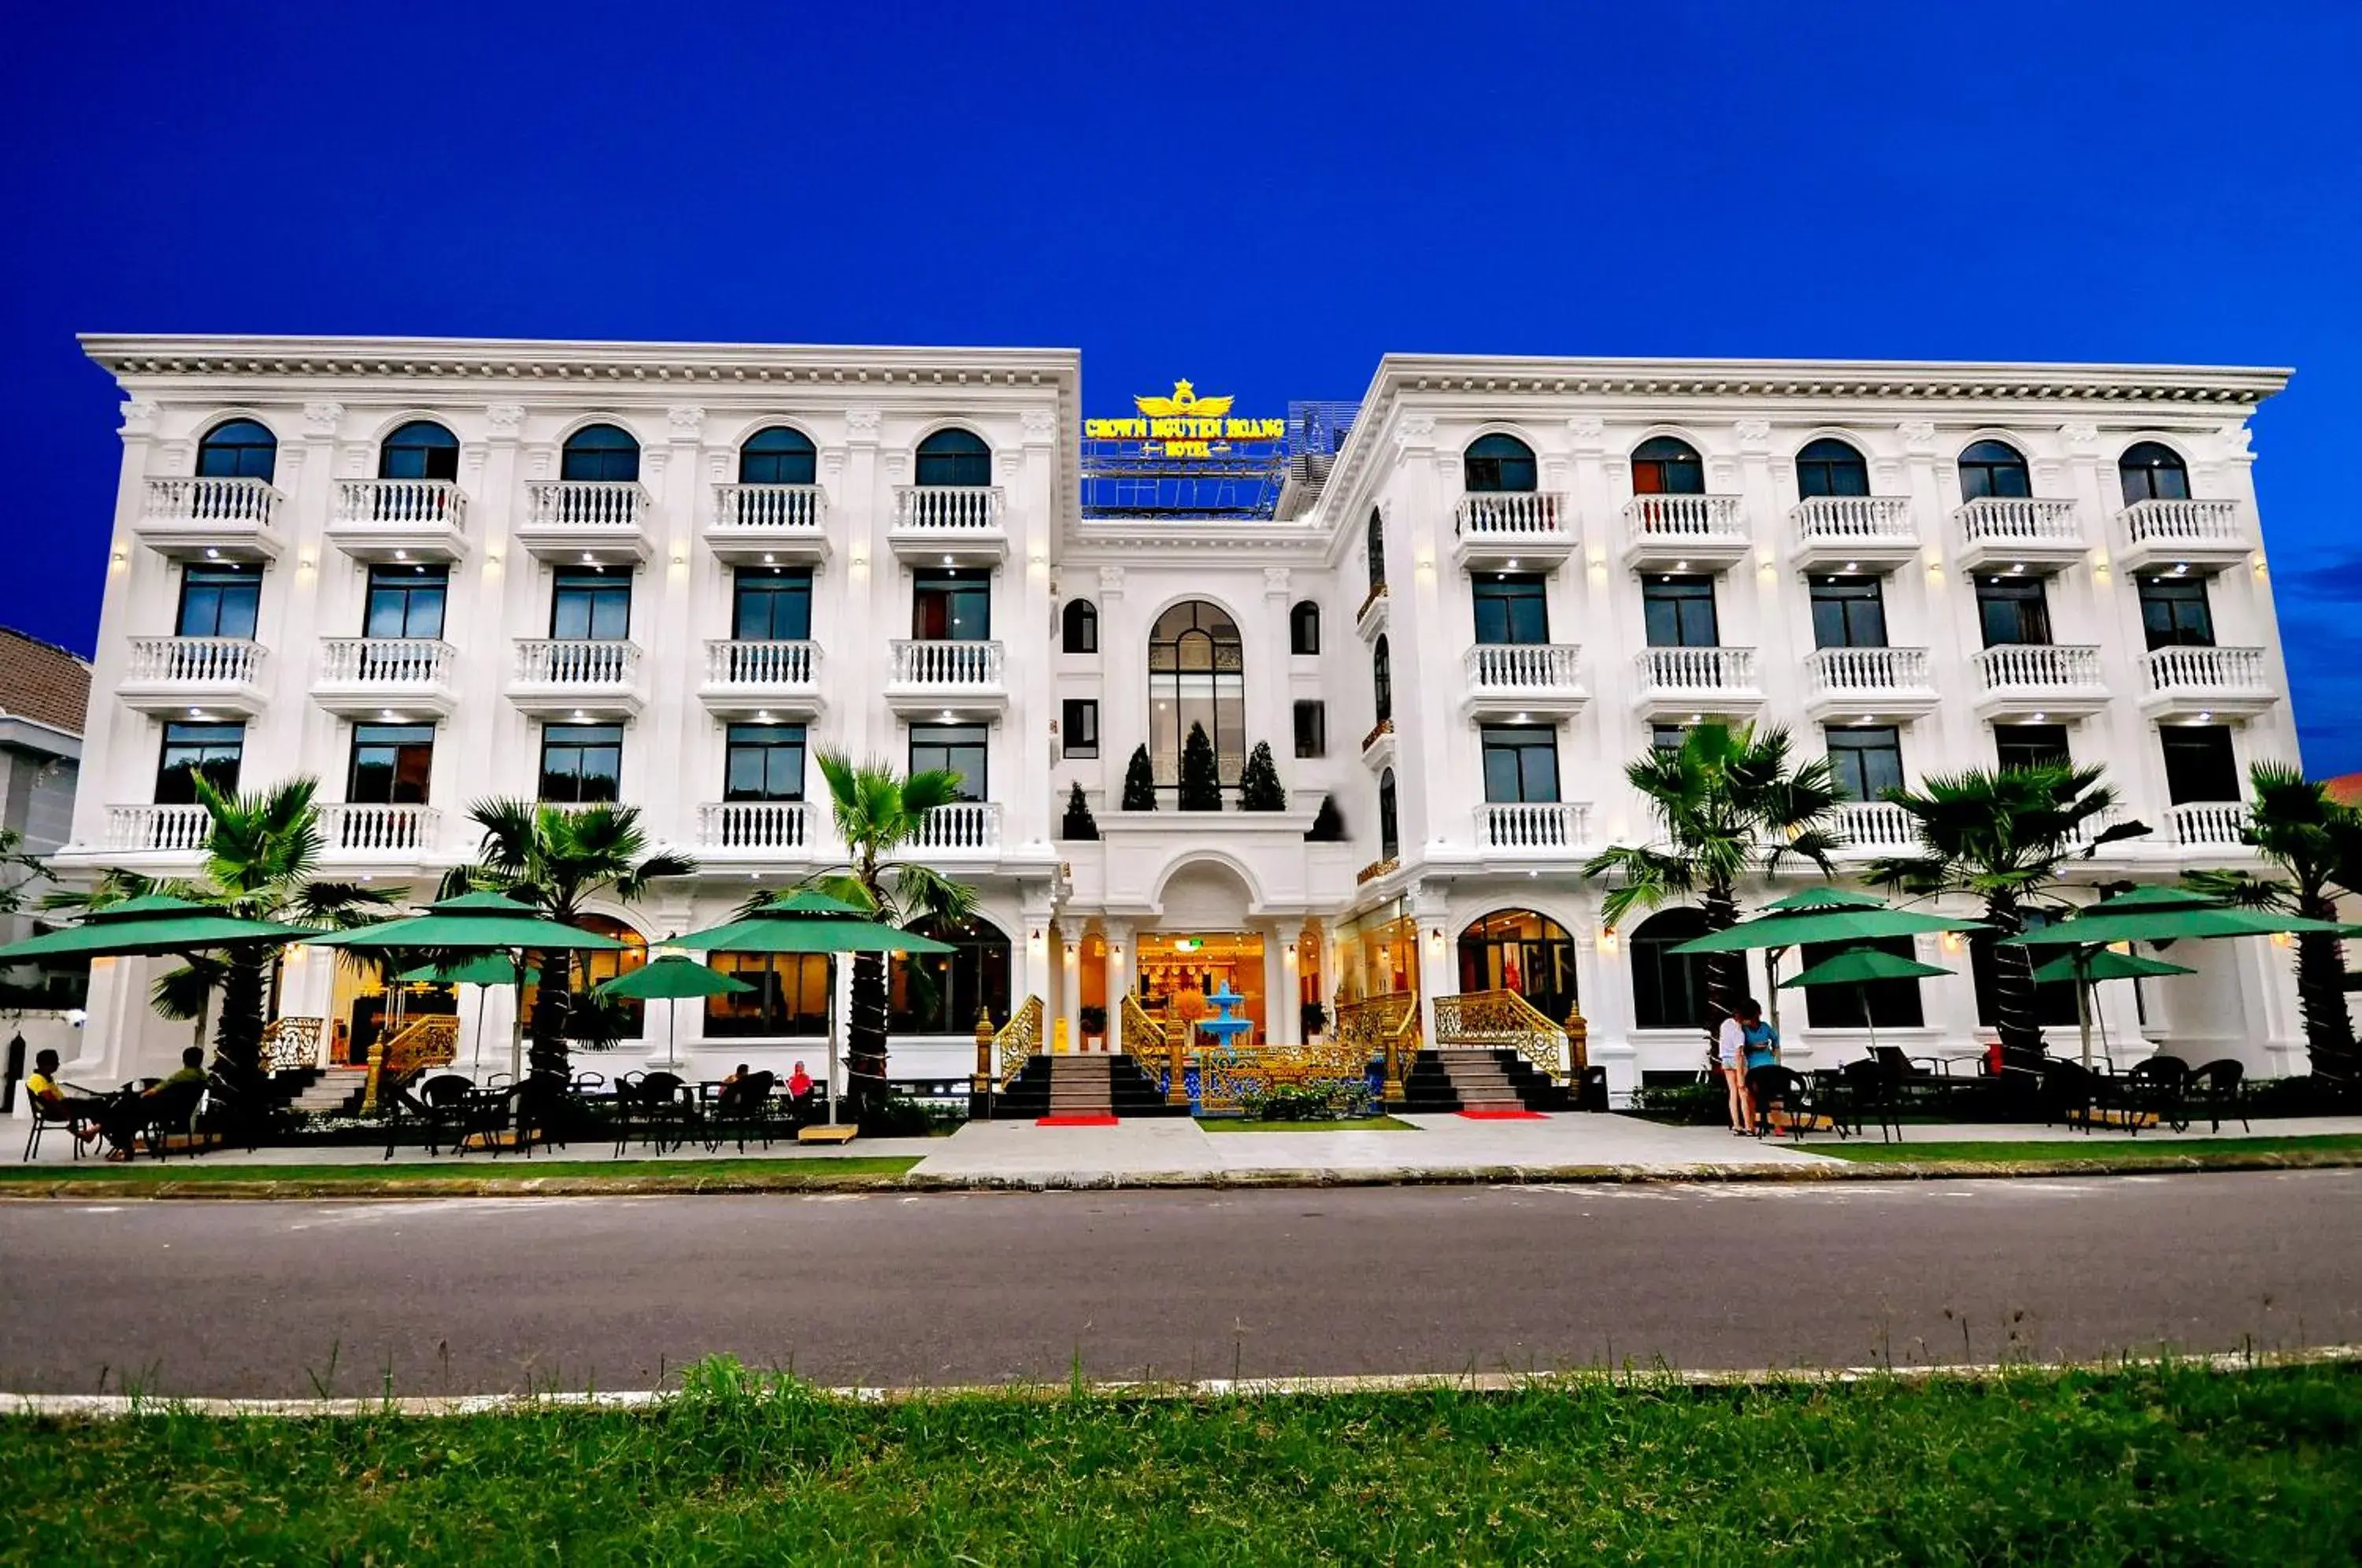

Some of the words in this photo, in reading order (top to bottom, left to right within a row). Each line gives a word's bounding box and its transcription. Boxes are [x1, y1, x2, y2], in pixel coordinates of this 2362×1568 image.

[1085, 418, 1147, 438] CROWN
[1151, 418, 1221, 438] NGUYEN
[1226, 418, 1284, 438] HOANG
[1165, 440, 1210, 457] HOTEL
